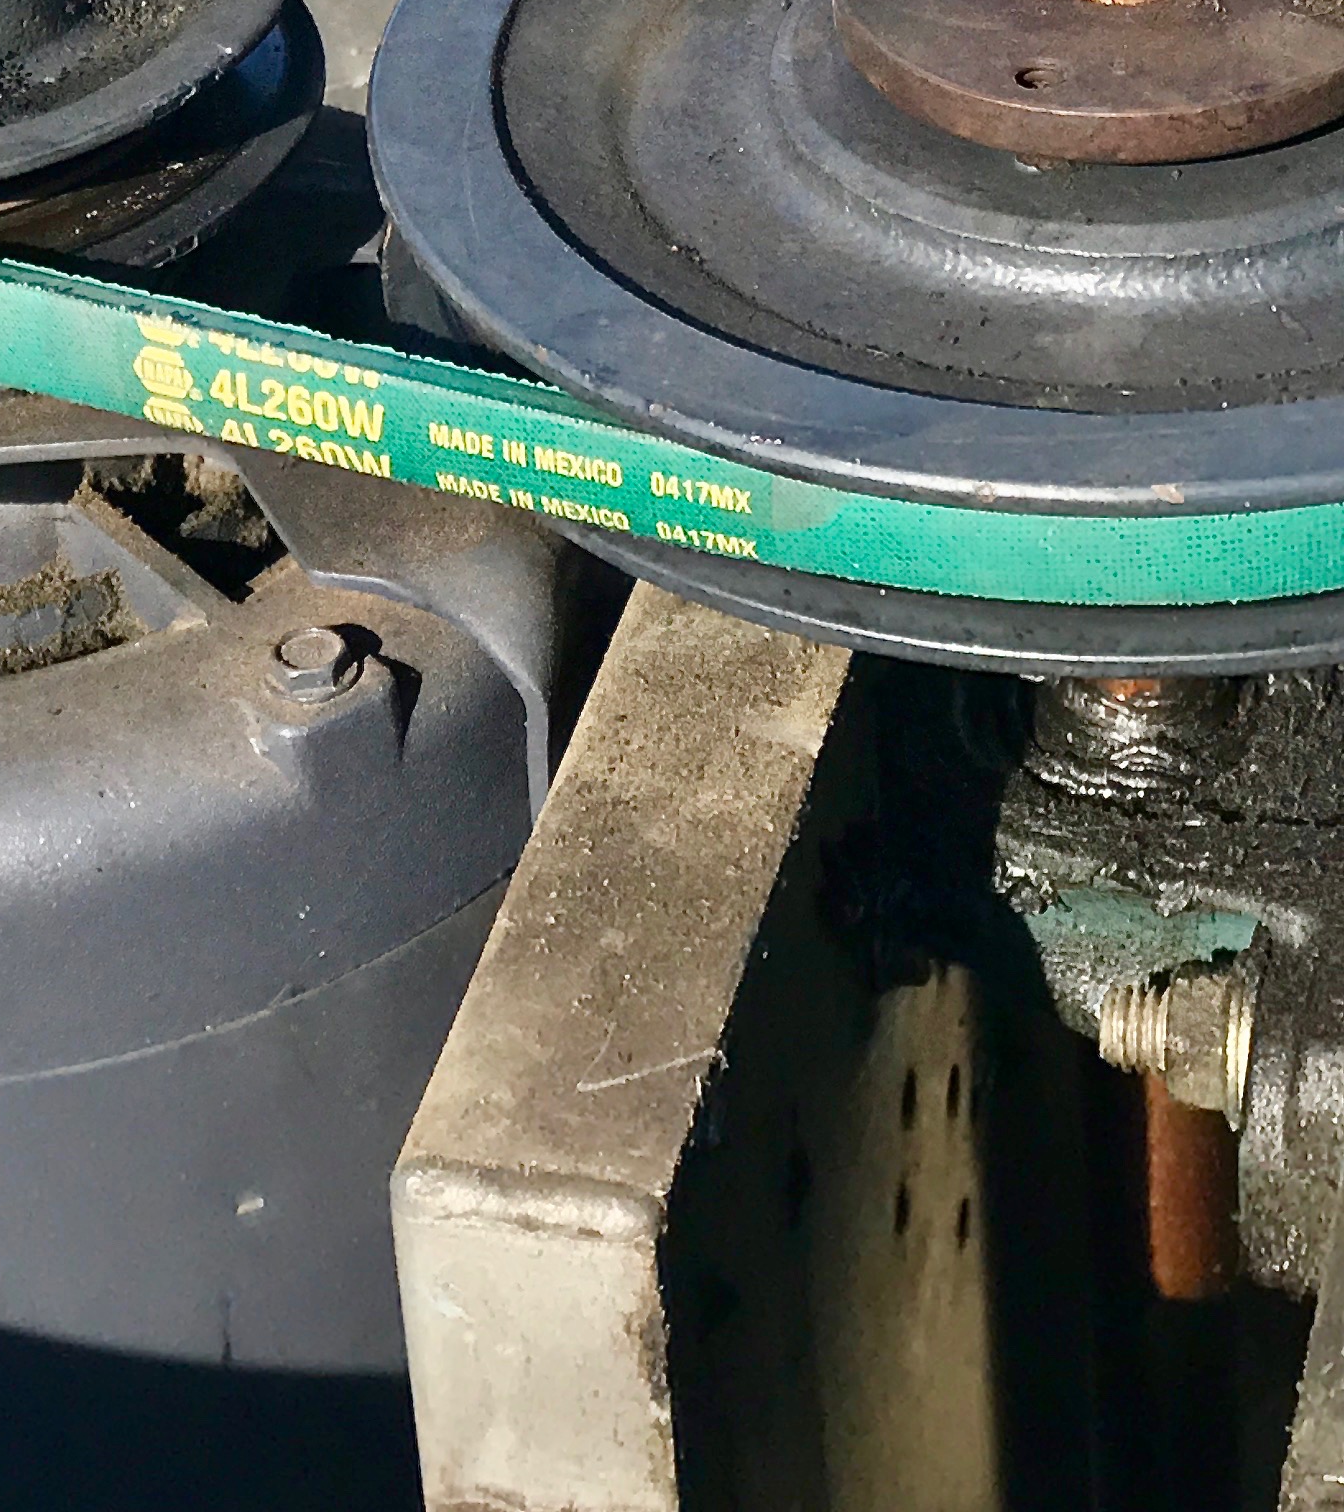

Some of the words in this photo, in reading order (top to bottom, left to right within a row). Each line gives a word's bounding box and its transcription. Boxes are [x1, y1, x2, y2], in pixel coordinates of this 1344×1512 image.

[208, 369, 385, 442] 4L260W
[428, 422, 494, 459] MADE
[502, 438, 528, 468] IN
[534, 445, 623, 488] MEXICO
[650, 471, 752, 514] 0417MX
[436, 472, 504, 504] MADE
[509, 489, 535, 511] IN
[540, 496, 631, 531] MEXICO
[655, 521, 759, 559] 0417MX
